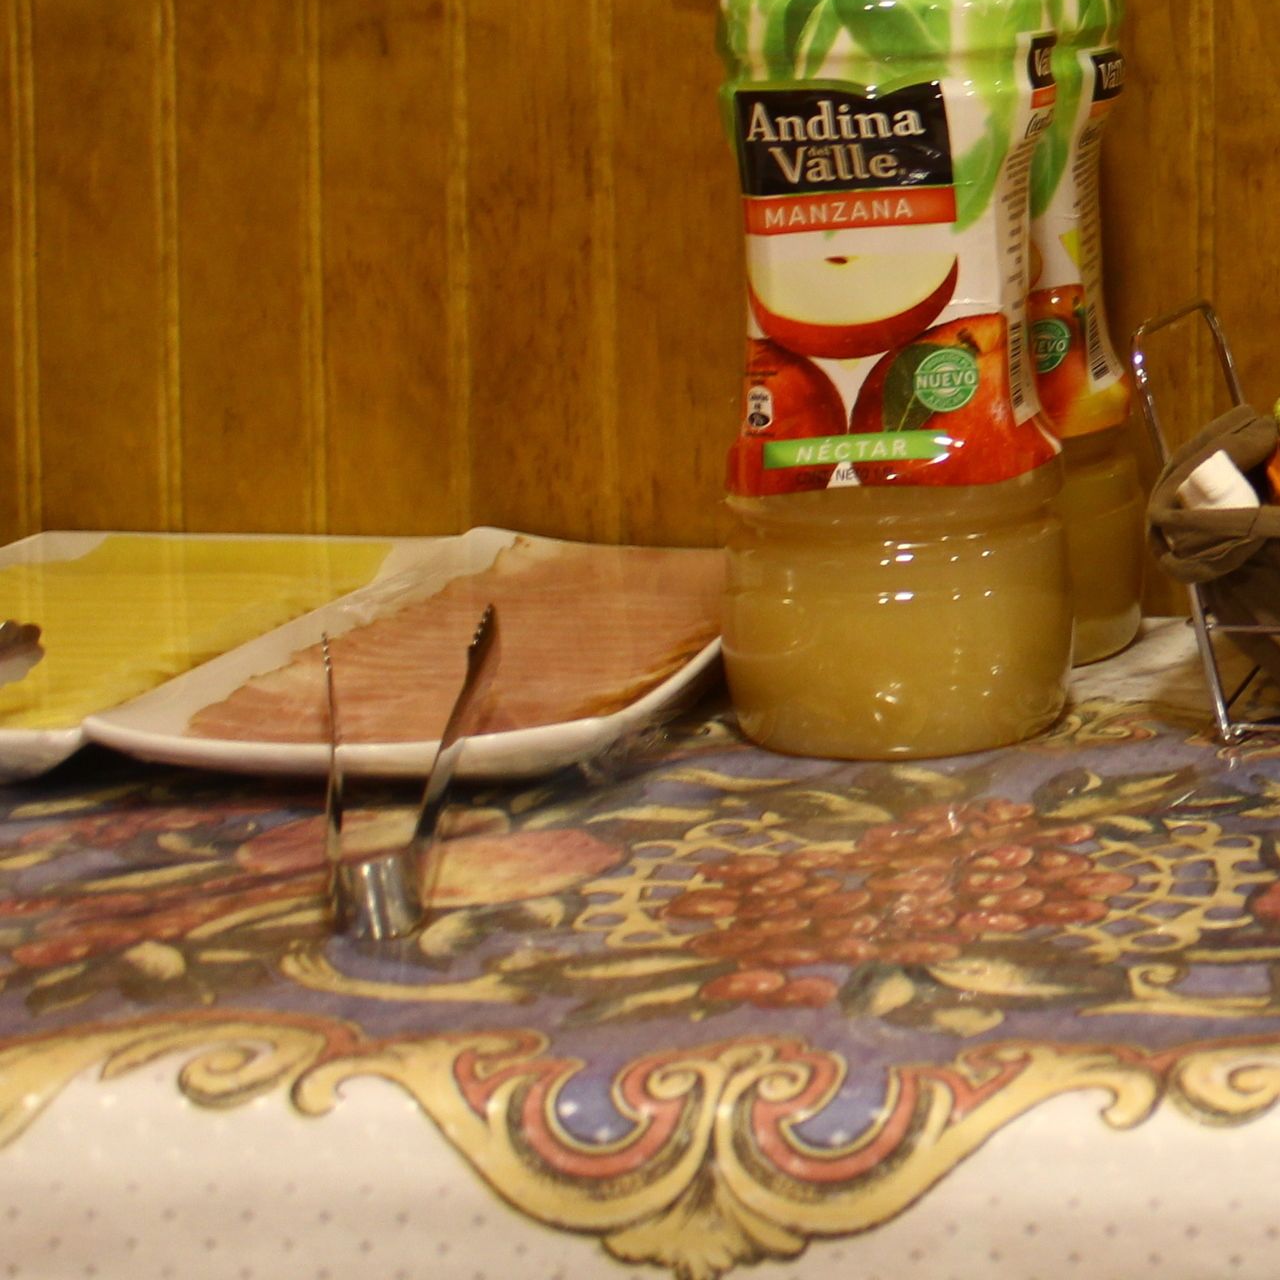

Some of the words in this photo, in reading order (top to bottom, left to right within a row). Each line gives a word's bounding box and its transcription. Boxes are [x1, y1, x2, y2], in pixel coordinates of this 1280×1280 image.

[746, 100, 927, 142] Andina
[768, 143, 899, 184] Valle
[808, 144, 831, 158] del
[764, 198, 914, 229] MANZANA
[915, 370, 977, 390] NUEVO
[794, 438, 908, 463] NÉCTAR
